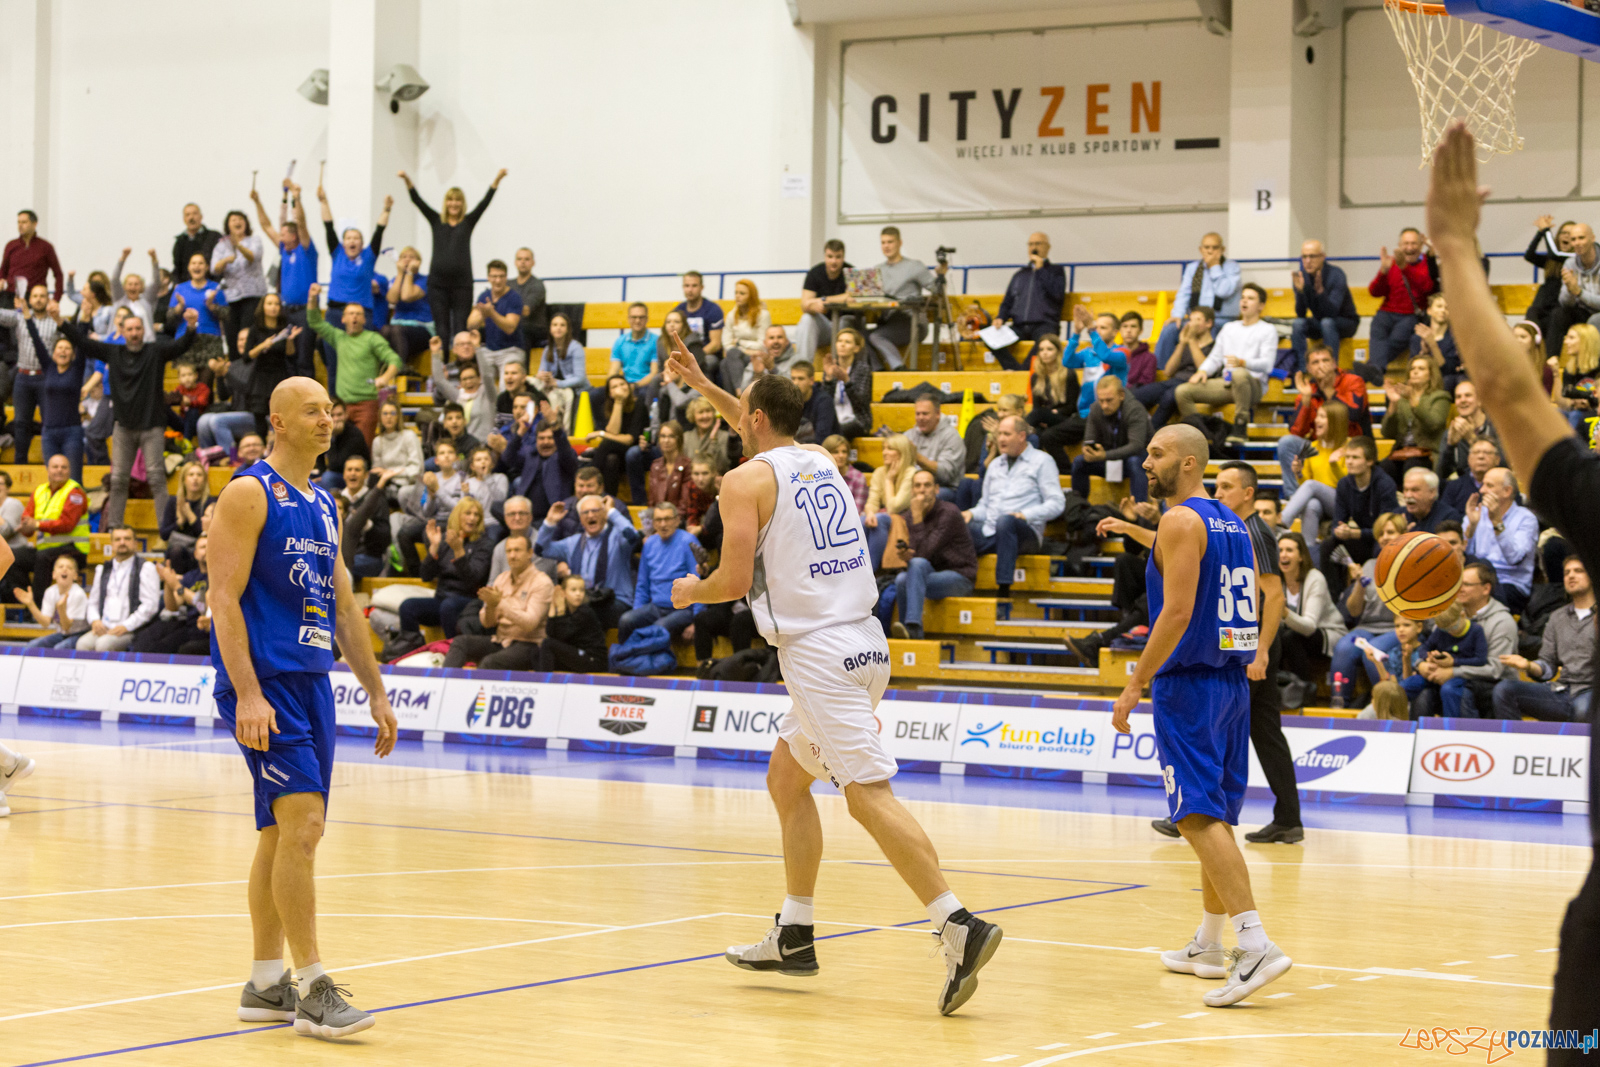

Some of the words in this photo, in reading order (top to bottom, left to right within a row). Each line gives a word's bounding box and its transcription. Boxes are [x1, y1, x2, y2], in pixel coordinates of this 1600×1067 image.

[871, 81, 1162, 144] CITYZEN
[1040, 141, 1076, 155] KLUB
[1083, 139, 1161, 153] SPORTOWY
[1256, 189, 1272, 211] B
[795, 483, 860, 550] 12
[1217, 564, 1258, 622] 33
[334, 685, 432, 711] BIOARM
[491, 684, 539, 697] fundacja
[485, 695, 535, 729] PBG
[604, 706, 646, 720] JOKER
[895, 720, 951, 741] DELIK
[1000, 724, 1095, 747] funclub
[999, 742, 1034, 751] biuro
[1296, 750, 1350, 769] atrem
[1433, 752, 1482, 773] KIA
[1512, 756, 1584, 778] DELIK
